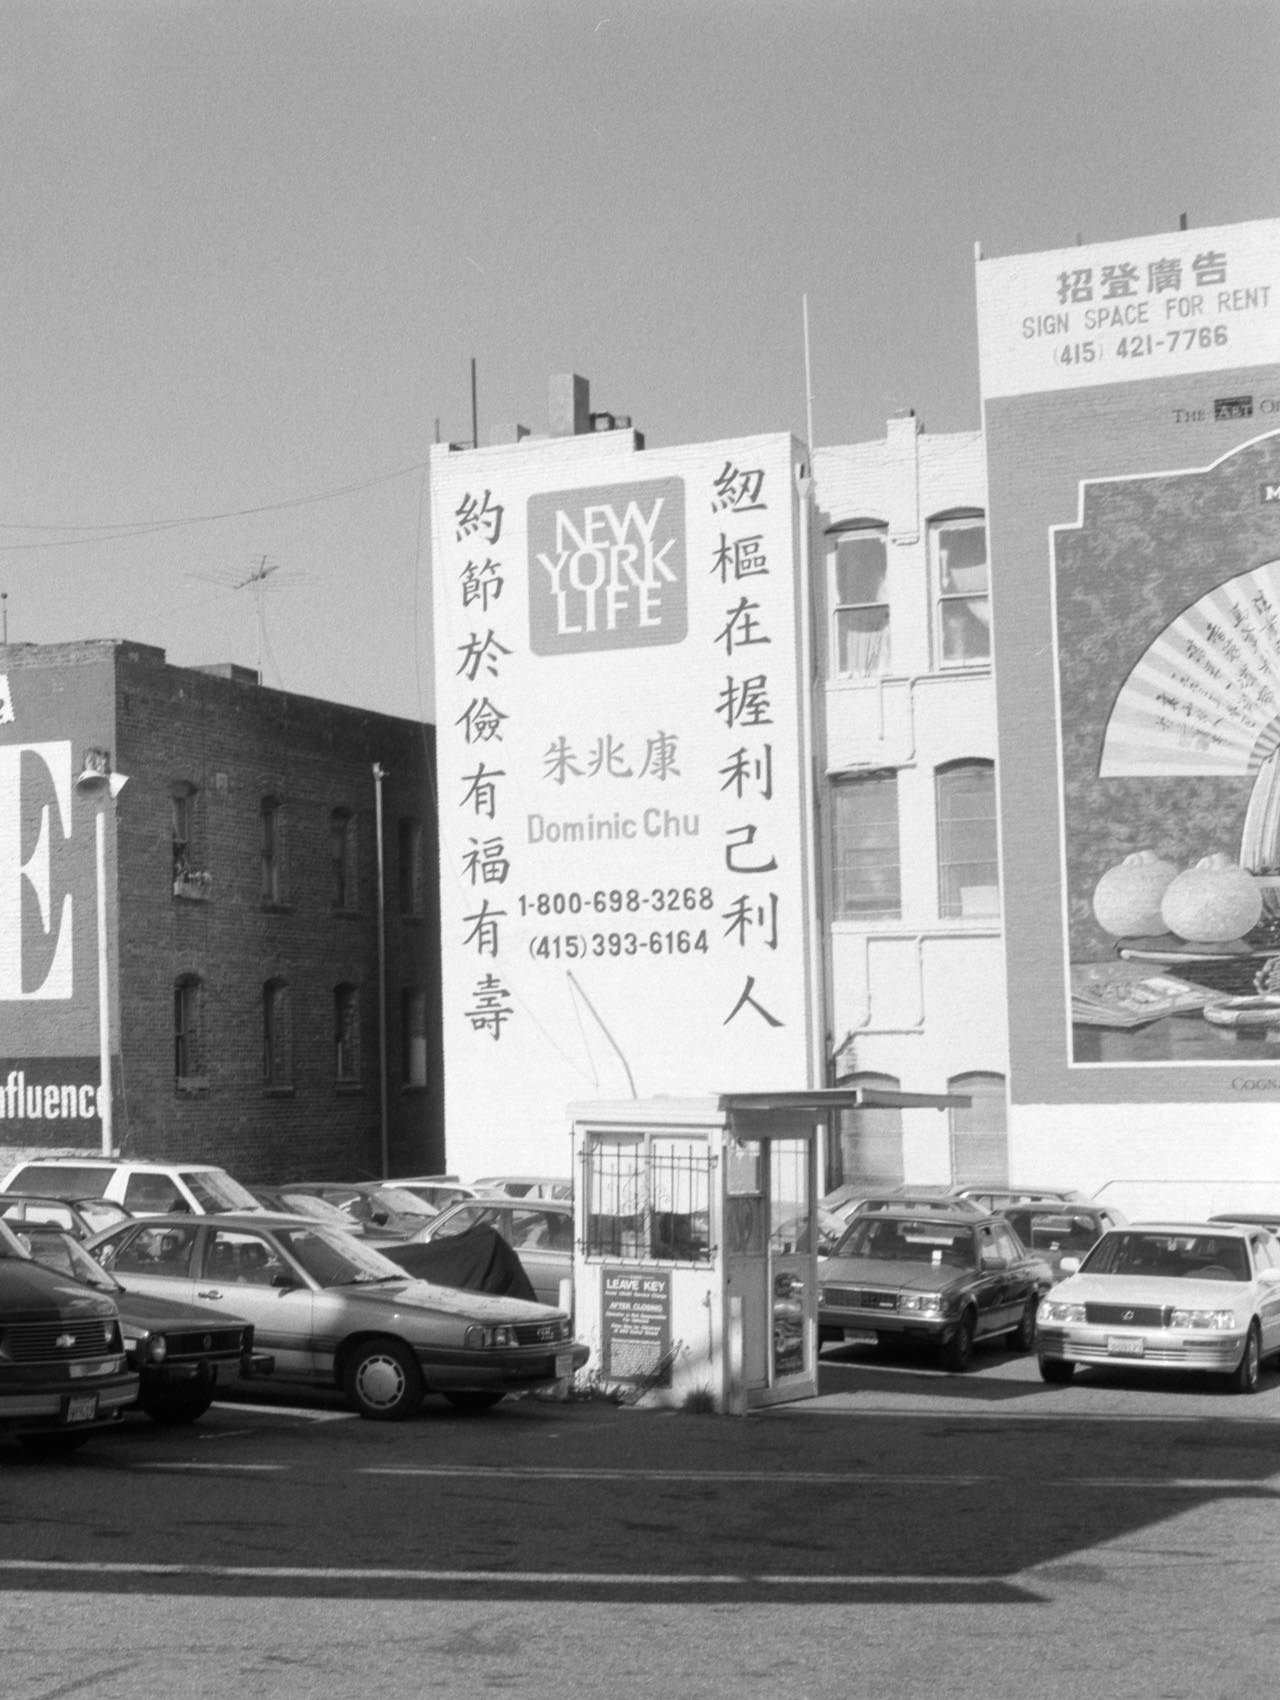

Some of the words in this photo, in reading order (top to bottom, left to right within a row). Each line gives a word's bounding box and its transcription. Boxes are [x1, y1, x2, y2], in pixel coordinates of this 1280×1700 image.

[1056, 250, 1228, 306] 招登廣告
[1021, 312, 1070, 339] SIGN
[1083, 301, 1150, 331] SPACE
[1165, 294, 1205, 321] FOR
[1217, 285, 1272, 313] RENT
[1052, 340, 1104, 368] (415)
[1115, 325, 1229, 360] 421-7766
[555, 497, 666, 554] NEW
[535, 537, 679, 595] YORK
[556, 581, 663, 636] LIFE
[542, 729, 682, 786] 朱兆康
[526, 812, 638, 845] Dominic
[642, 807, 701, 839] Chu
[517, 885, 715, 917] 1-800-698-3268
[606, 1278, 640, 1291] LEAVE
[643, 1280, 666, 1293] KEY
